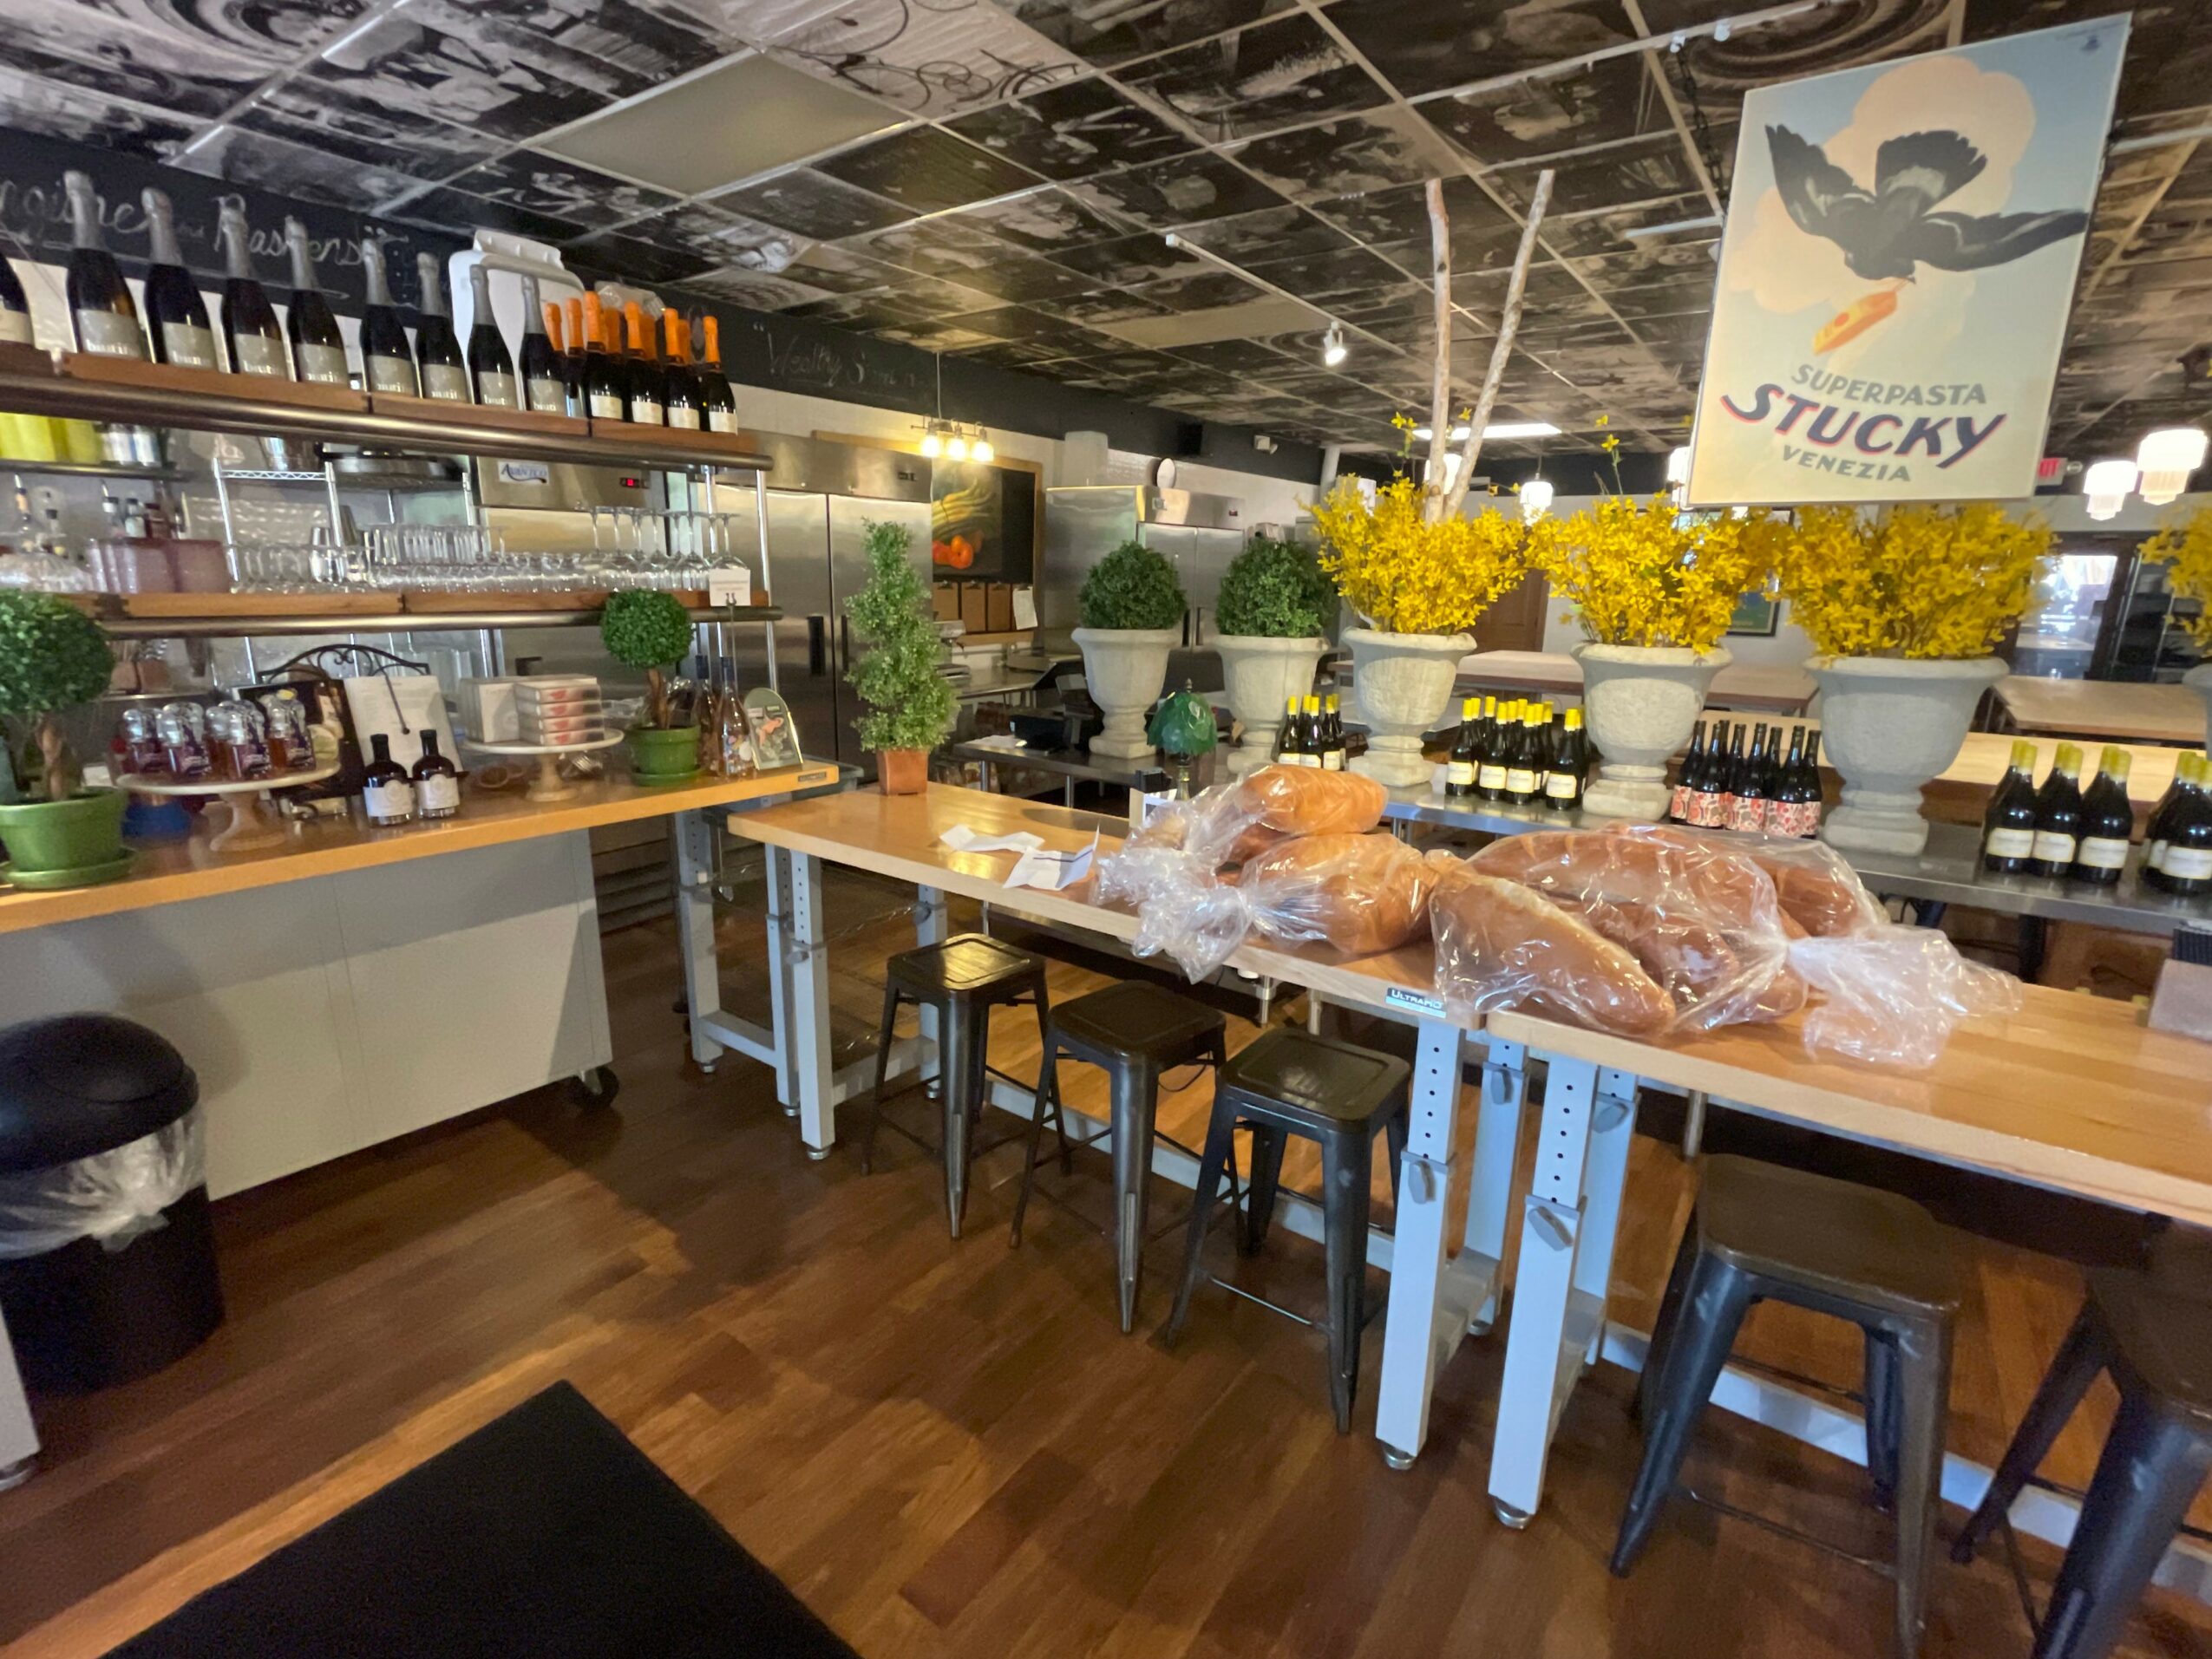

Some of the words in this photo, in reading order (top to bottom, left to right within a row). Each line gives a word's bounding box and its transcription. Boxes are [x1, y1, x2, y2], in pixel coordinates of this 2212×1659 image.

[1790, 363, 1987, 406] SUPERPASTA
[1719, 382, 2007, 469] STUCKY
[1782, 444, 1912, 482] VENEZIA
